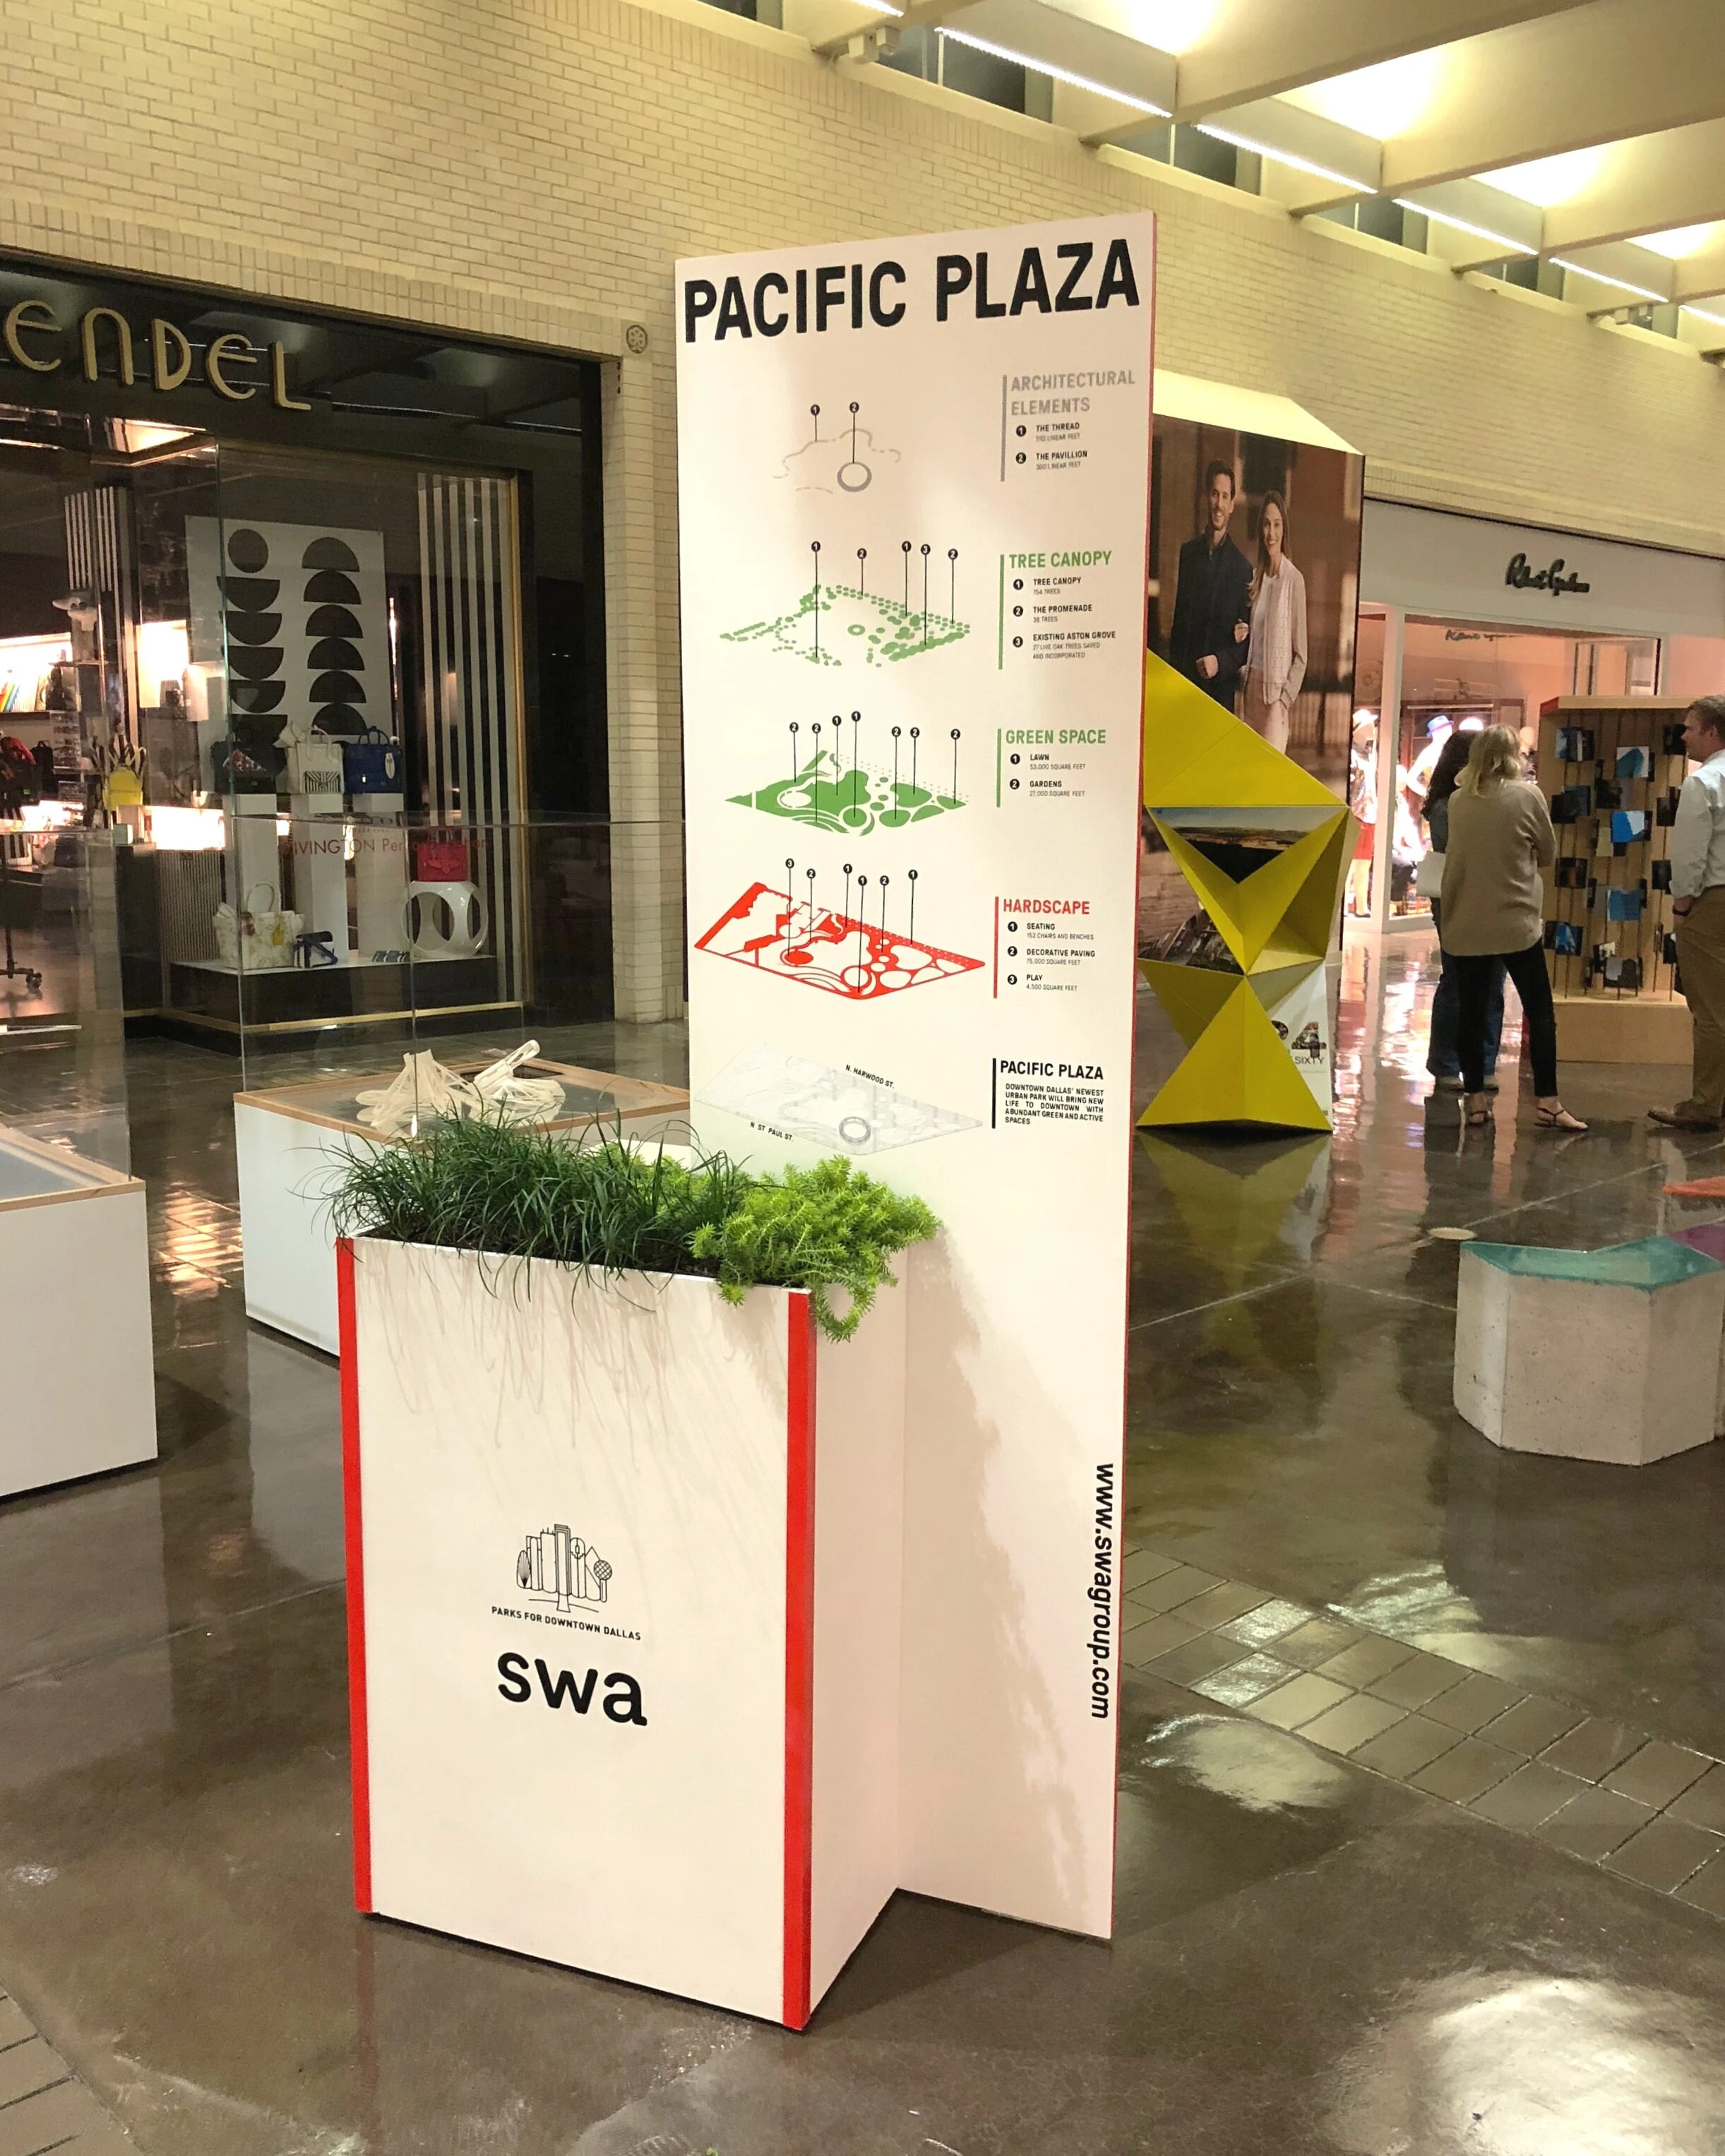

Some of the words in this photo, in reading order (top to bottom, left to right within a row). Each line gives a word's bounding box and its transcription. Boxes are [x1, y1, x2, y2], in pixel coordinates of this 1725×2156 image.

[684, 260, 907, 344] PACIFIC
[936, 239, 1140, 323] PLAZA
[1011, 371, 1135, 391] ARCHITECTURAL
[1011, 397, 1090, 415] ELEMENTS
[1052, 422, 1080, 431] THREAD
[1051, 450, 1087, 460] PAVILLION
[1009, 553, 1046, 568] TREE
[1051, 551, 1112, 567] CANOPY
[1006, 730, 1053, 744] GREEN
[1059, 729, 1106, 743] SPACE
[1003, 899, 1090, 914] HARDSCAPE
[1295, 1056, 1325, 1065] SIXTY
[853, 1067, 884, 1084] HARWOOD
[1001, 1060, 1053, 1076] PACIFIC
[1058, 1064, 1104, 1079] PLAZA
[1005, 1083, 1044, 1092] DOWNTOWN
[1041, 1102, 1080, 1111] DOWNTOWN
[768, 1128, 783, 1138] PAUL
[1087, 1463, 1114, 1719] www.swagroup.com
[491, 1606, 522, 1619] PARKS
[524, 1612, 542, 1622] FOR
[545, 1616, 600, 1633] DOWNTOWN
[604, 1627, 641, 1641] DALLAS
[497, 1652, 647, 1726] swa
